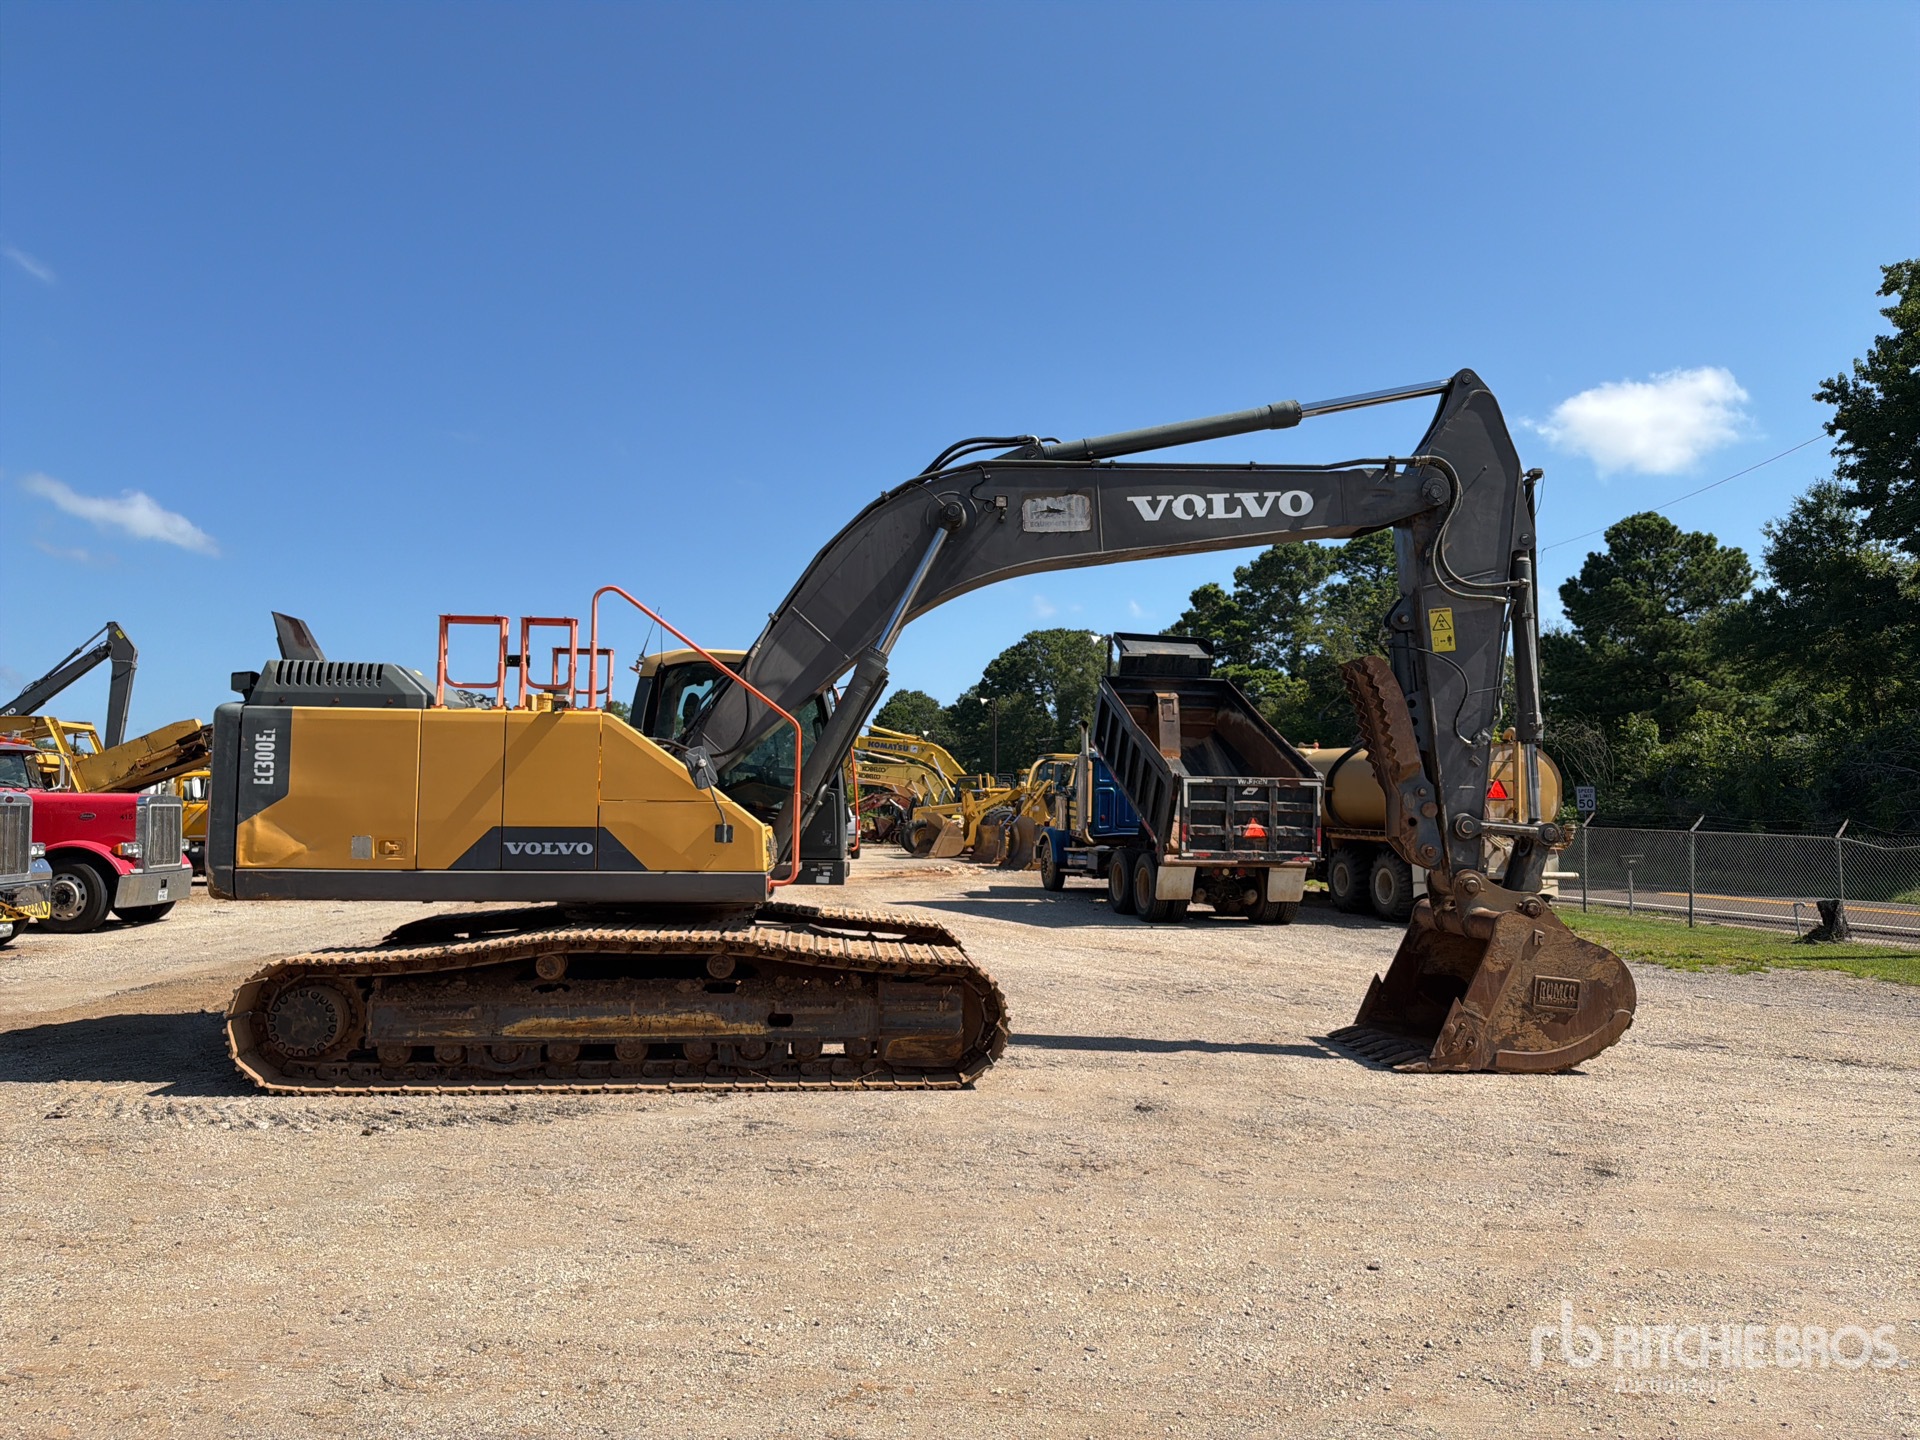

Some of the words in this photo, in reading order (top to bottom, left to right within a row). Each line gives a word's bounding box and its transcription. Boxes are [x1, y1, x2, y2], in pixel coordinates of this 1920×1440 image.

[1126, 490, 1314, 521] VOLVO
[868, 741, 909, 752] KOMATSU
[861, 765, 886, 773] KOBELCO
[1578, 798, 1594, 809] 50
[503, 842, 594, 855] VOLVO
[1540, 981, 1577, 999] ROMCO
